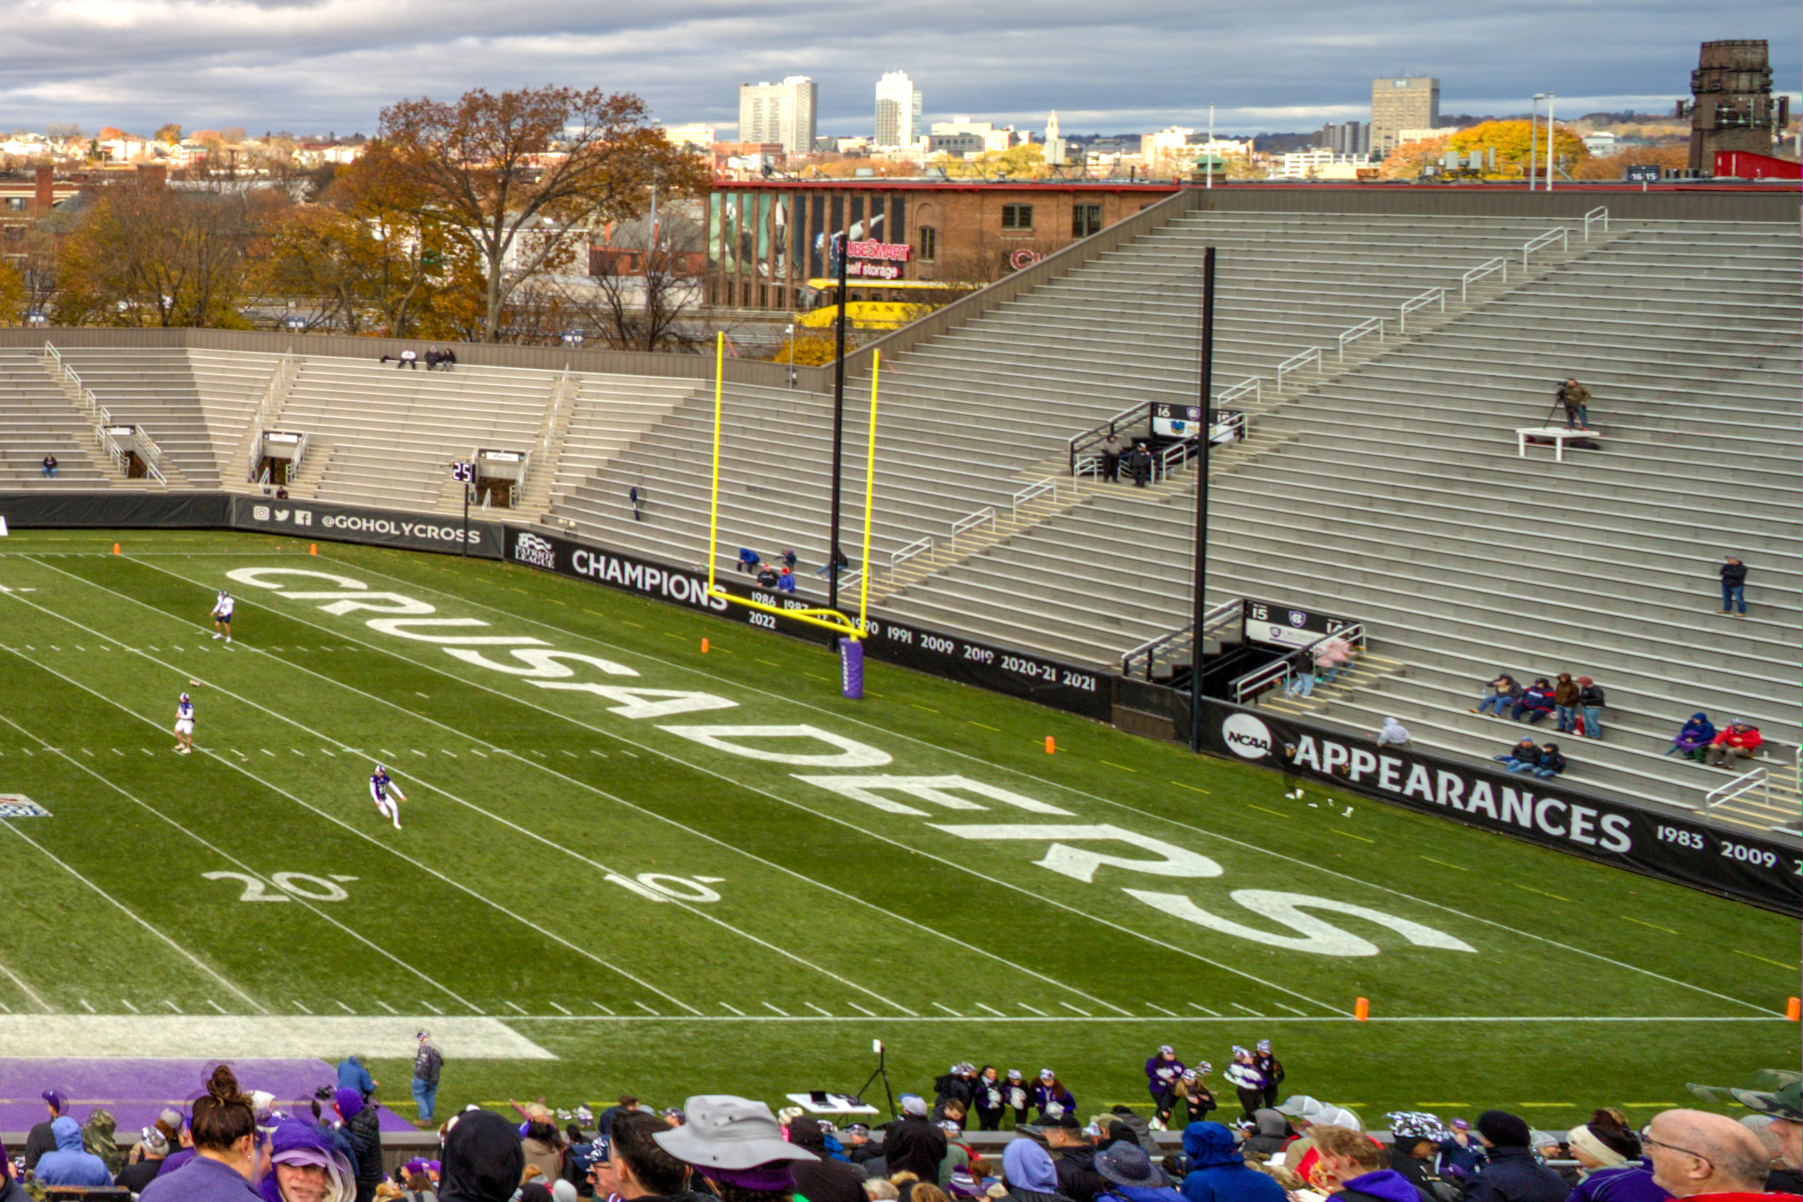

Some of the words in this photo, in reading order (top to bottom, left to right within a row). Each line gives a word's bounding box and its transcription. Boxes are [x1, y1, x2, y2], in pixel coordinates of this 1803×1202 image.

[838, 238, 910, 262] UBESMART
[862, 262, 899, 280] storage
[1157, 407, 1170, 418] 16
[452, 462, 471, 482] 25
[322, 515, 481, 544] @GOHOLYCROSS
[515, 545, 555, 562] PATRIOT
[515, 551, 555, 569] LEAGUE
[572, 549, 728, 611] CHAMPIONS
[749, 611, 776, 630] 2022
[1252, 607, 1269, 620] 15
[751, 591, 776, 608] 1986
[887, 626, 913, 644] 1991
[920, 634, 954, 654] 2009
[963, 645, 994, 665] 2019
[1001, 655, 1056, 682] 2020-21
[1062, 671, 1097, 692] 2021
[1228, 731, 1271, 752] NCAA
[226, 566, 1479, 958] CRUSADERS
[1294, 733, 1633, 853] APPEARANCES
[1656, 824, 1705, 850] 1983
[1720, 840, 1778, 868] 2009
[202, 871, 349, 902] 20
[604, 870, 722, 904] 10
